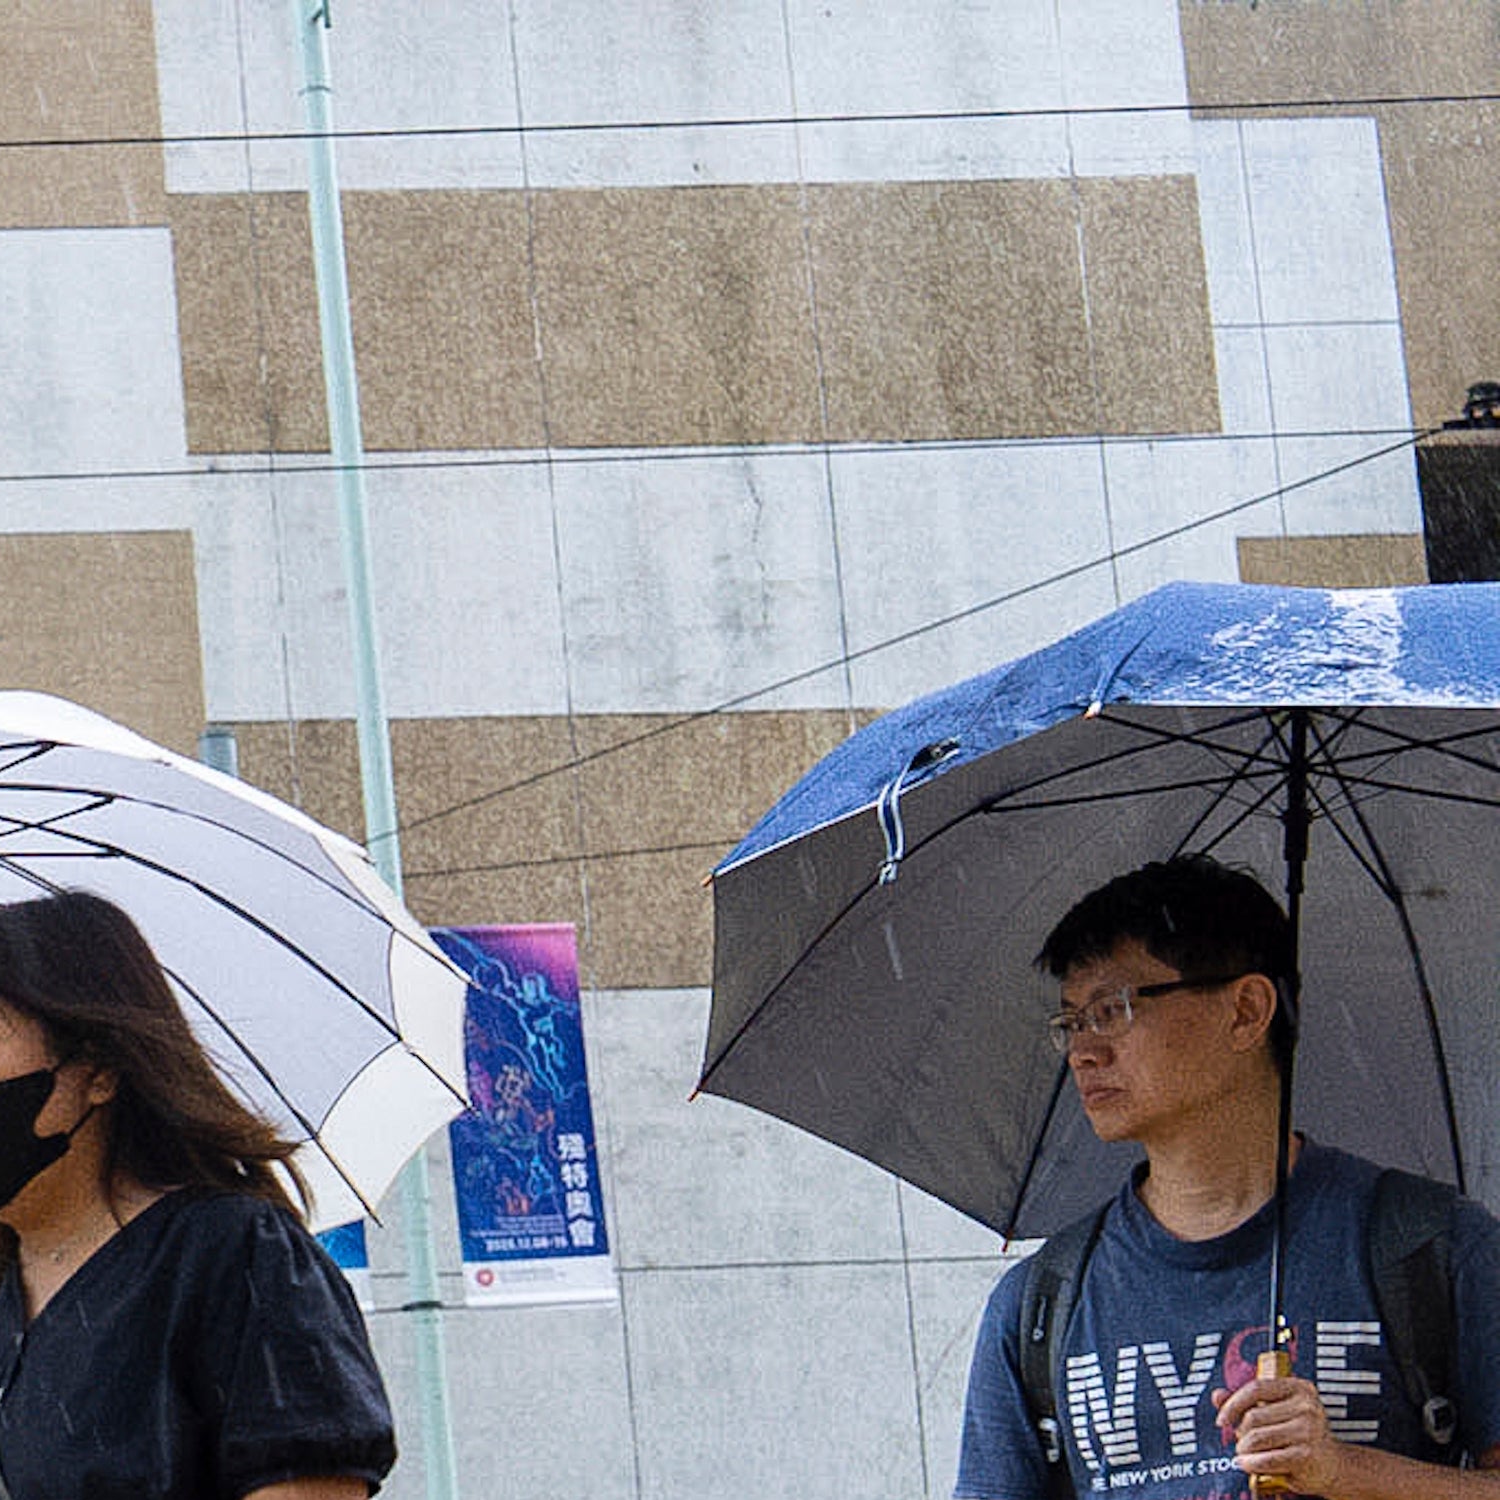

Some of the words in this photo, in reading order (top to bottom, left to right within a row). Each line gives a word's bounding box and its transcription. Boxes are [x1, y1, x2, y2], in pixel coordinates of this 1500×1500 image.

[1109, 1470, 1148, 1489] NEW
[1150, 1462, 1195, 1483] YORK
[1197, 1456, 1244, 1475] STOC
